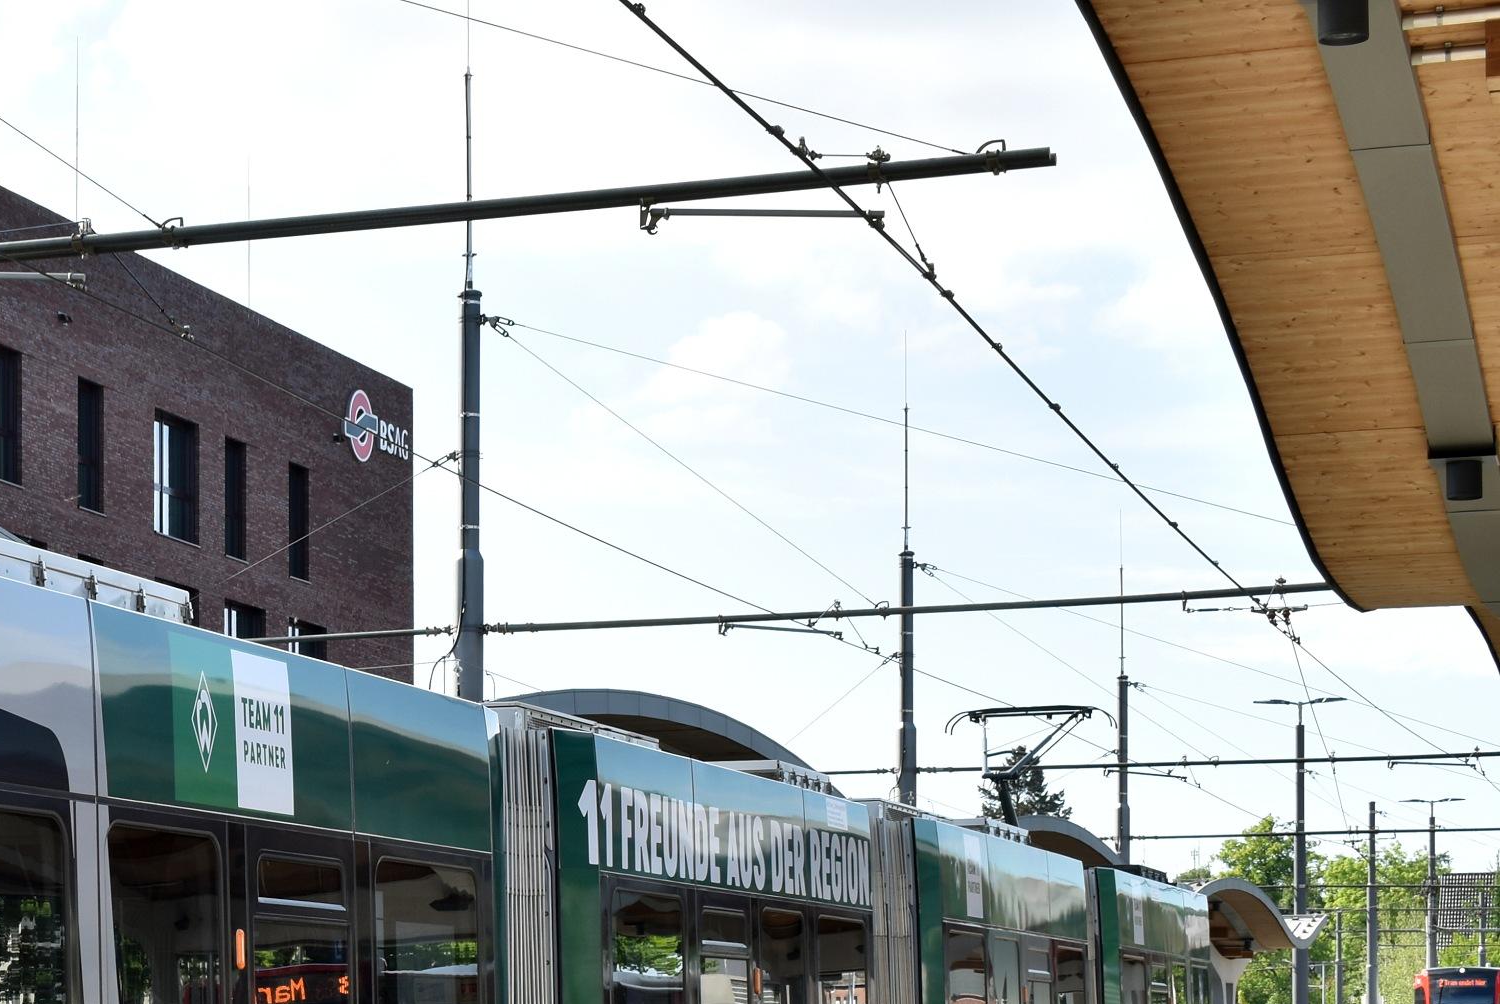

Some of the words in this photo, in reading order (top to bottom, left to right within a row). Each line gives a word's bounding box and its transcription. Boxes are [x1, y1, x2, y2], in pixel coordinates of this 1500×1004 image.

[380, 420, 408, 460] BSAG
[241, 697, 271, 732] TEAM
[274, 705, 285, 735] 11
[244, 740, 286, 770] PARTNER
[578, 779, 613, 868] 11
[620, 786, 721, 884] FREUNDE
[727, 811, 765, 891] AUS
[770, 820, 806, 897] DER
